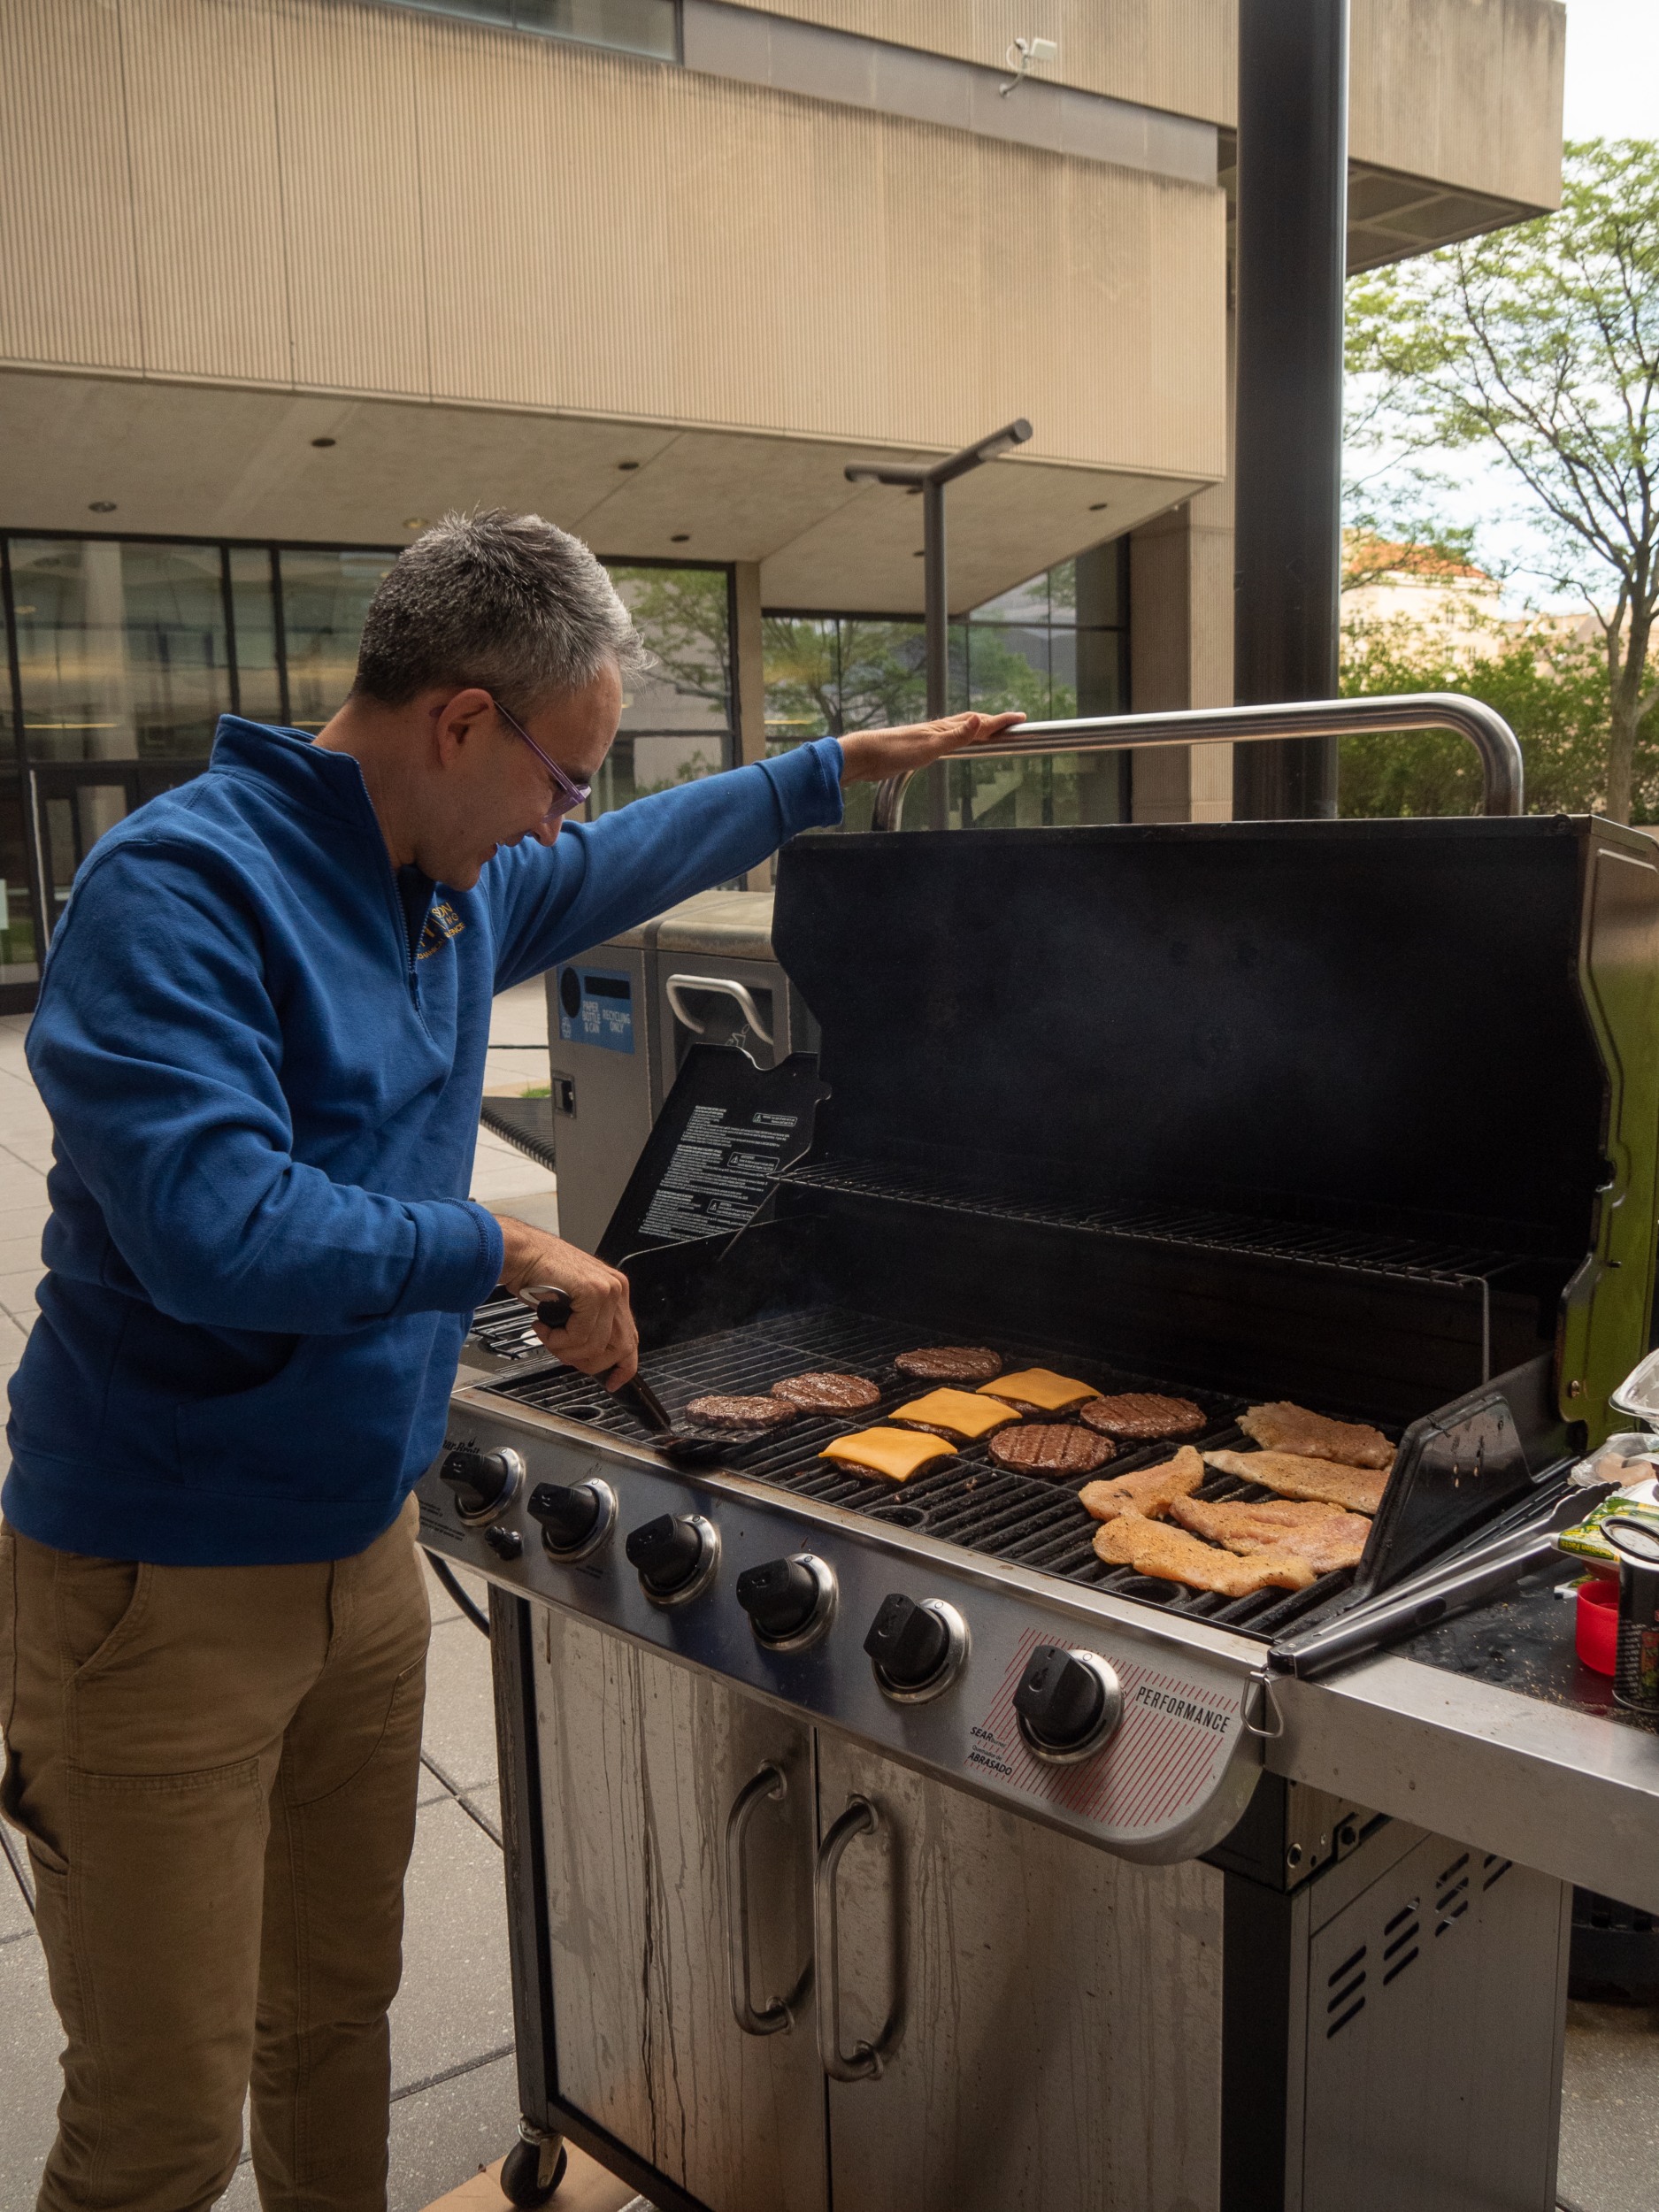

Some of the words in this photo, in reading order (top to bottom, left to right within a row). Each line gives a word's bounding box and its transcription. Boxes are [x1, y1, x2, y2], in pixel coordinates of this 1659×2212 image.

[582, 1001, 599, 1012] PAPER
[581, 1010, 601, 1025] BOTTLE
[602, 1009, 631, 1025] RECYCLING
[609, 1020, 625, 1033] ONLY
[1134, 1686, 1231, 1734] PERFORMANCE
[967, 1752, 1012, 1776] ABRASADO
